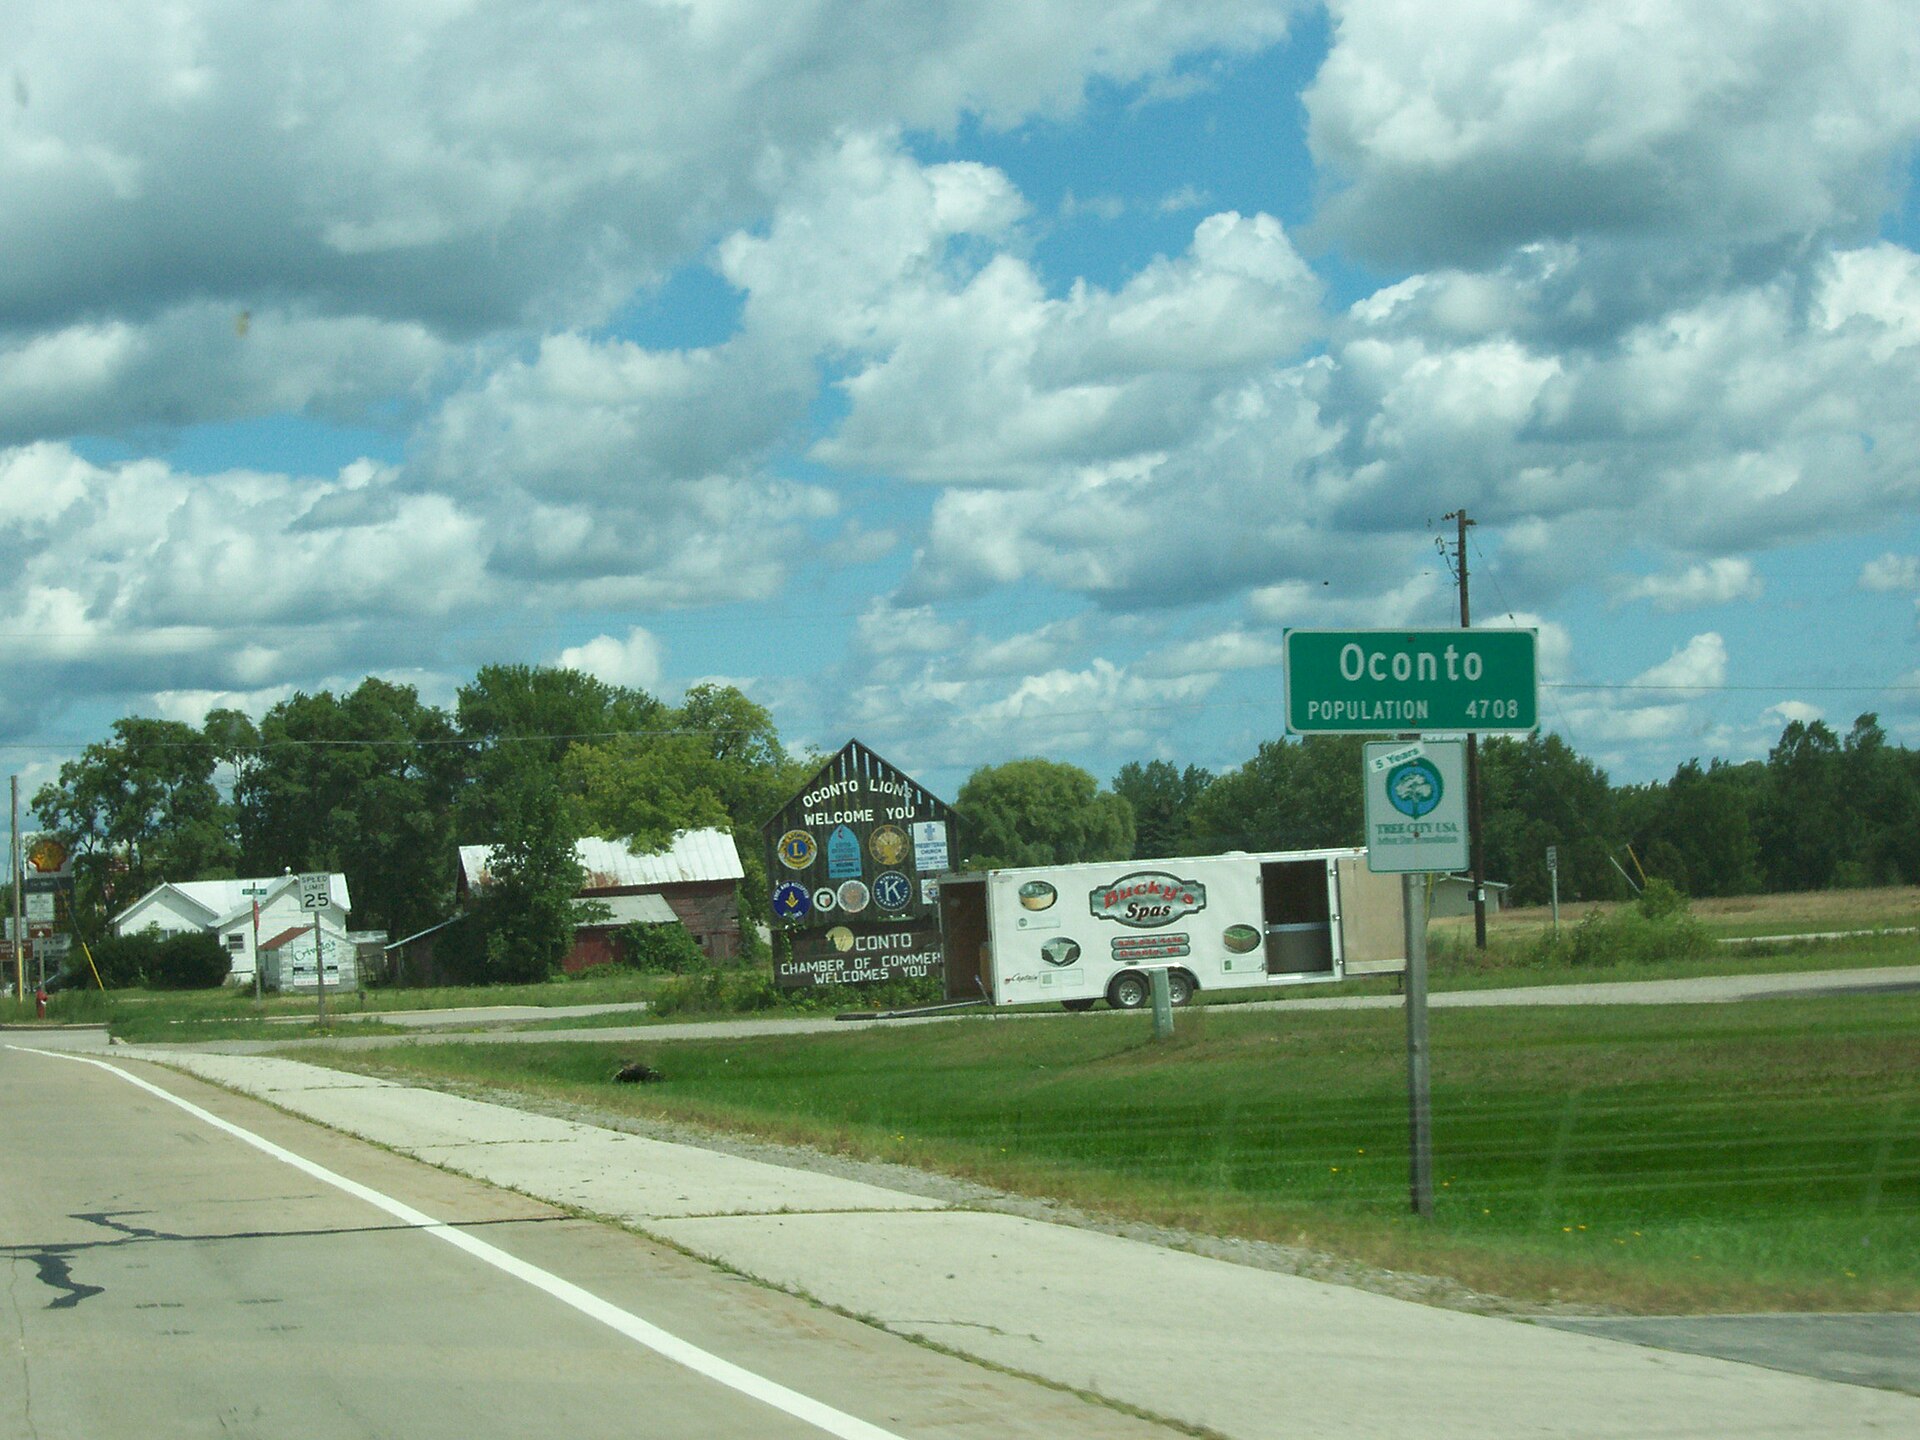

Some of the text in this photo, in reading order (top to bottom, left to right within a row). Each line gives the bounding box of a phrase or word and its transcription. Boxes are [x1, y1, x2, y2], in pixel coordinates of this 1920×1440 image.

[1340, 643, 1483, 681] Oconto
[1308, 699, 1518, 720] POPULATION 4708
[1386, 747, 1420, 763] Years
[802, 779, 913, 808] OCONTO LIONS
[804, 806, 915, 826] WELCOME YOU
[1375, 823, 1405, 835] TREE
[1406, 822, 1433, 834] CITY
[302, 875, 328, 883] SPEED
[304, 883, 325, 891] LIMIT
[884, 880, 901, 901] K
[1104, 881, 1194, 909] Bucky's
[304, 892, 329, 908] 25
[1125, 902, 1171, 920] Spas
[781, 959, 845, 975] CHAMBER
[855, 957, 872, 970] OF
[814, 965, 927, 984] WELCOMES YOU
